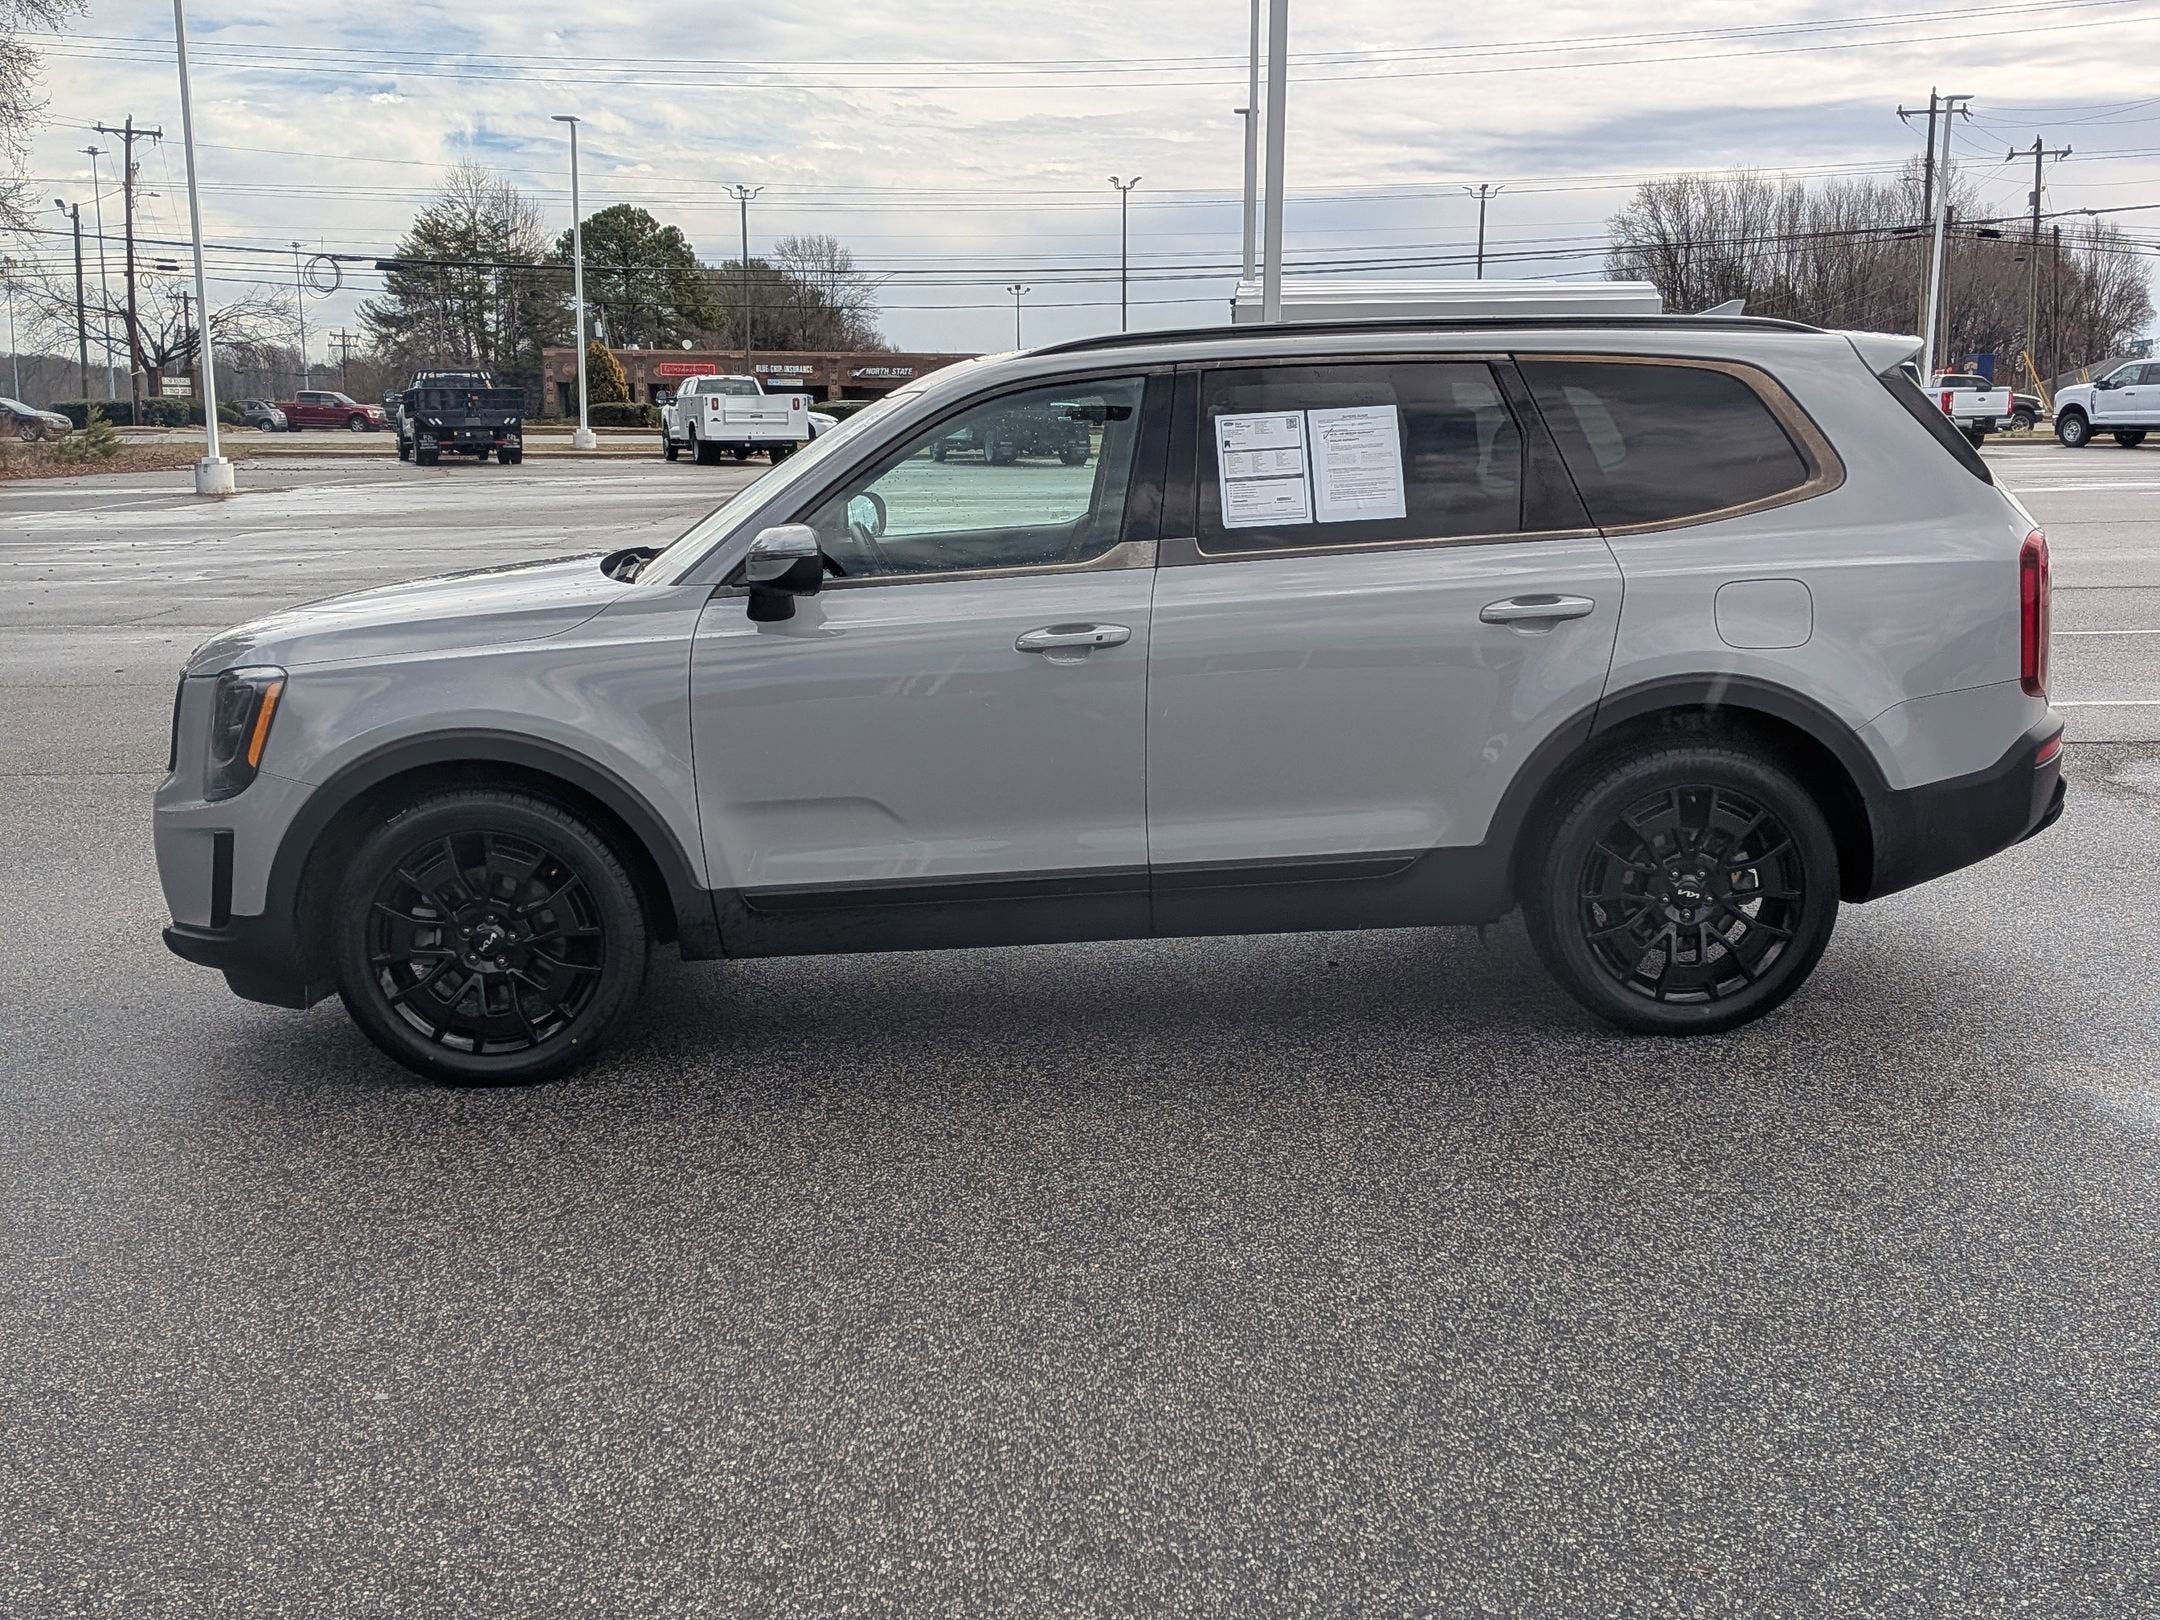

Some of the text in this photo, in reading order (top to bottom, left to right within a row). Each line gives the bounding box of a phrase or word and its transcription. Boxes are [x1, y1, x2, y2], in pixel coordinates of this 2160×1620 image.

[755, 364, 769, 373] BLUE
[783, 365, 814, 374] INSURANCE
[865, 367, 913, 376] NORTH STATE
